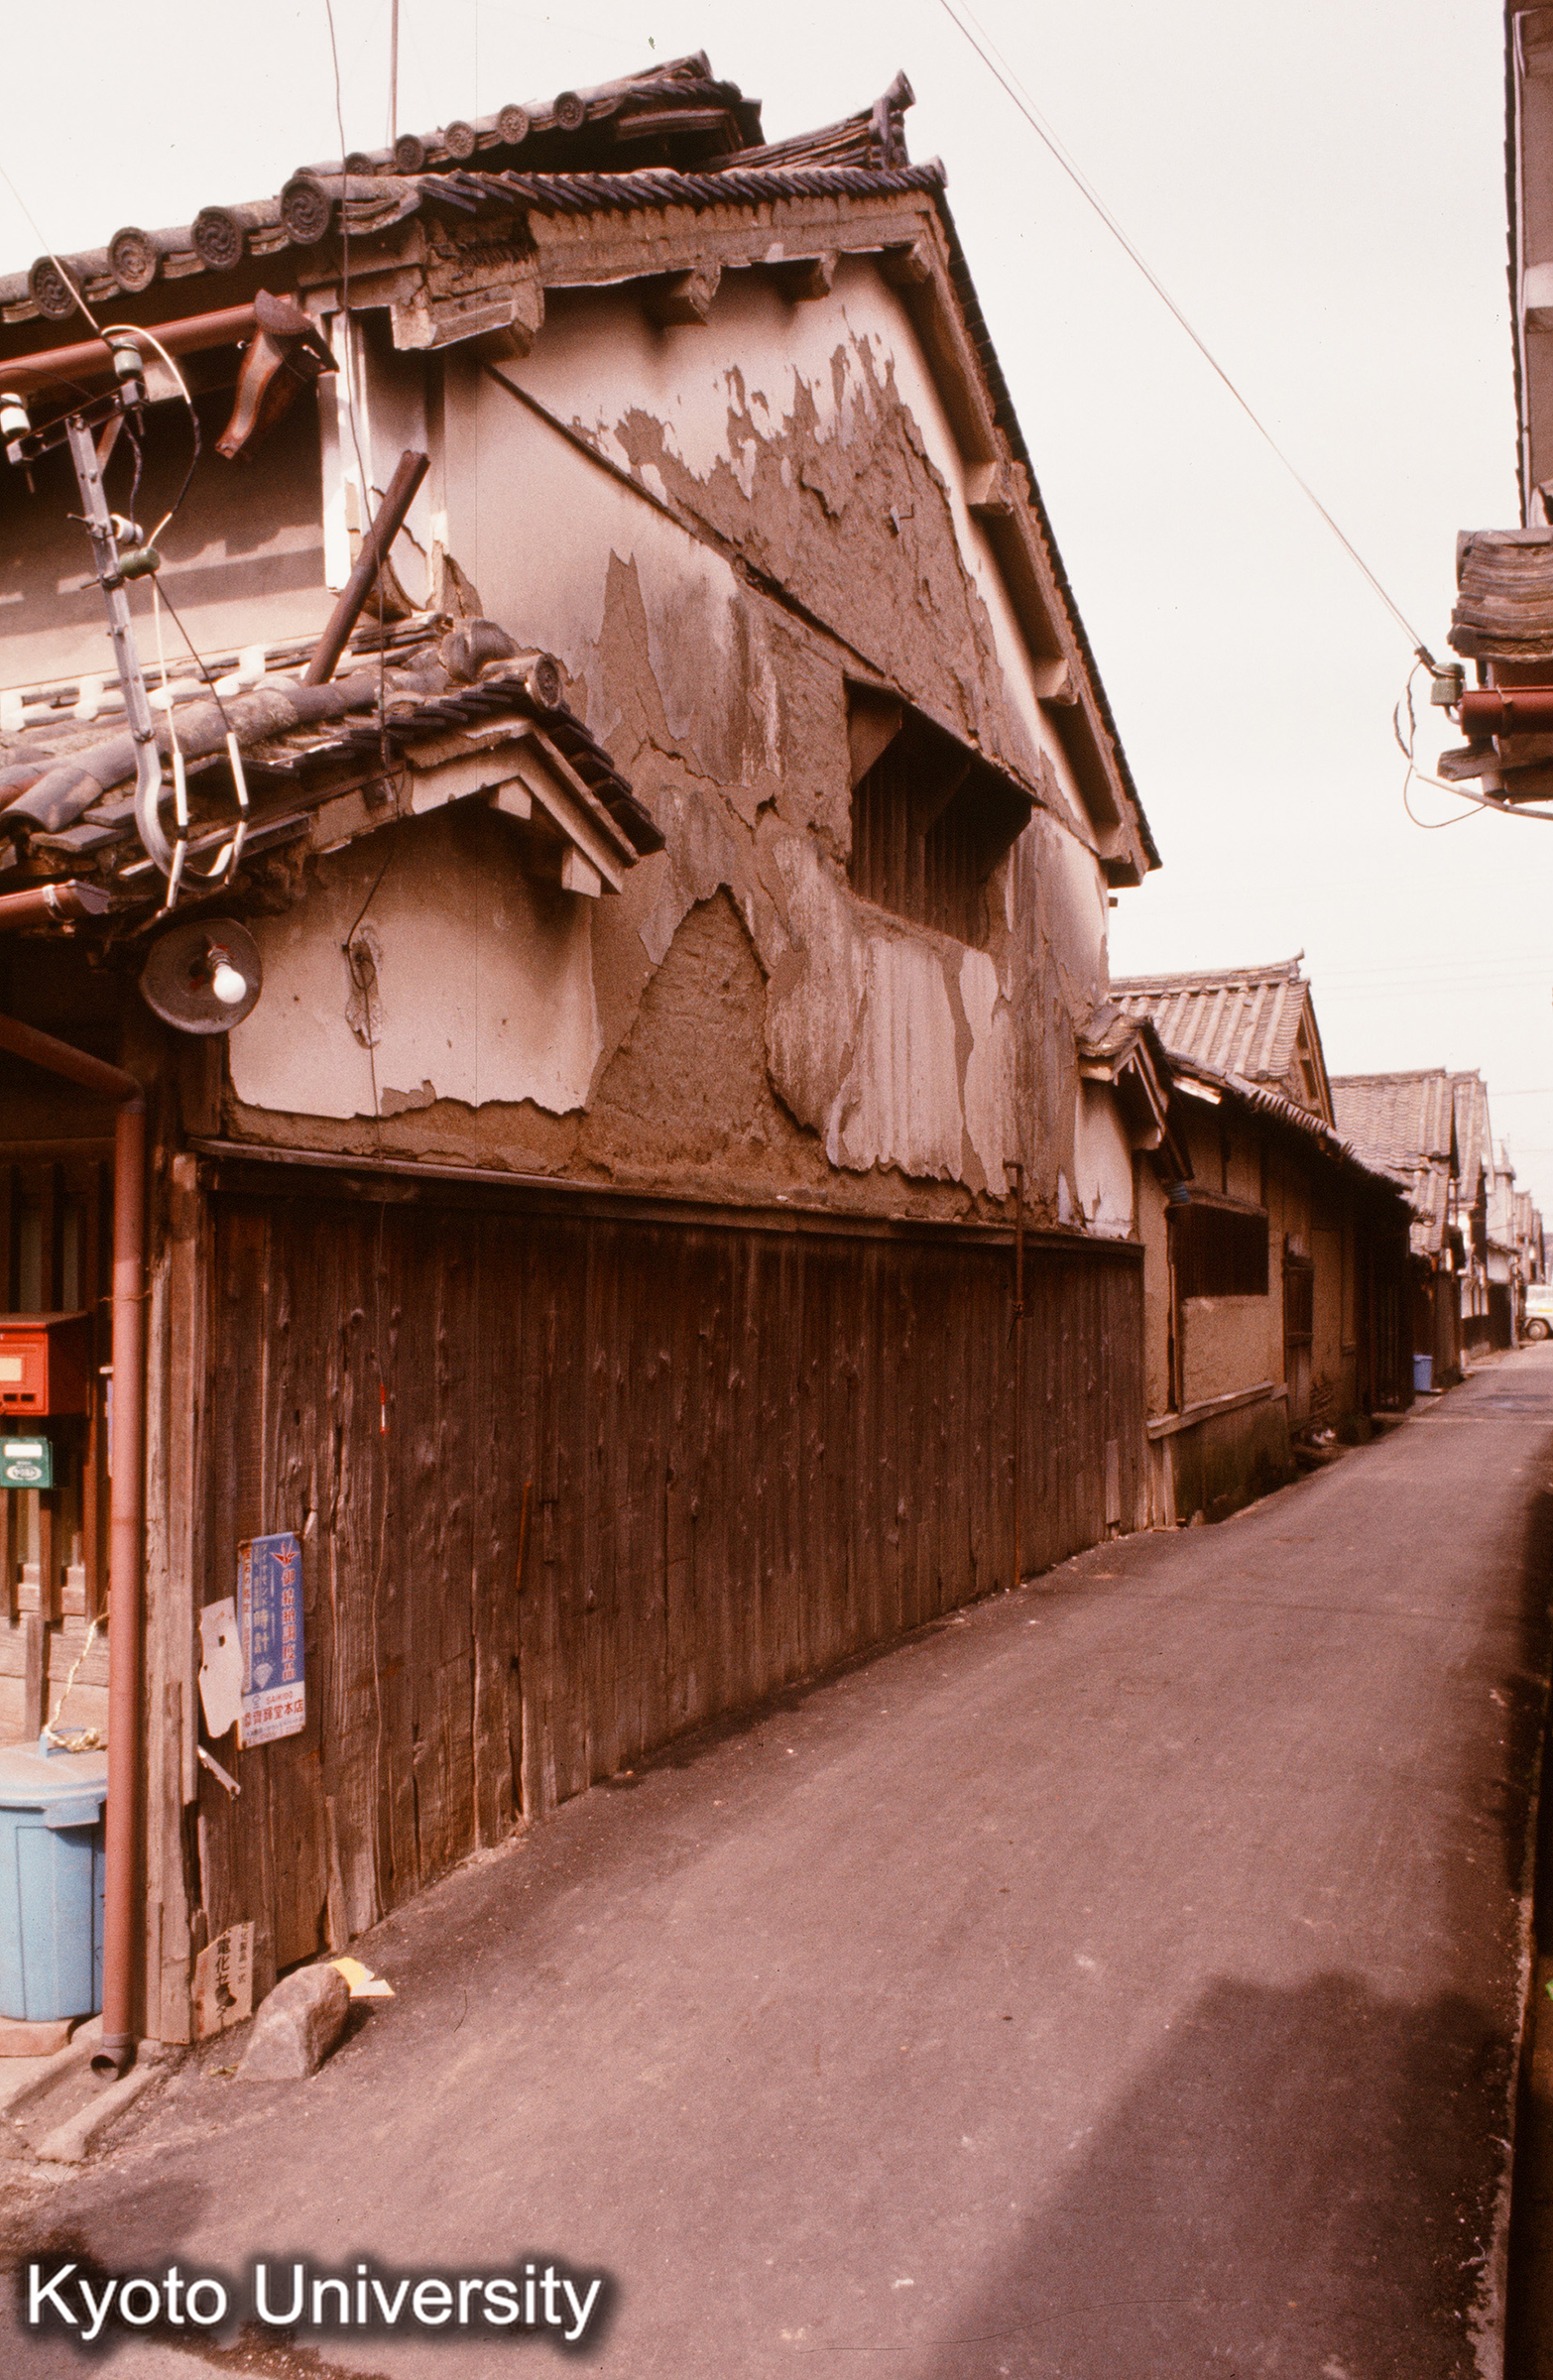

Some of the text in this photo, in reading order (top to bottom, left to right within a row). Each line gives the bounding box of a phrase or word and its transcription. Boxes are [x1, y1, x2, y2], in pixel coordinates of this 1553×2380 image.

[253, 1607, 270, 1654] 時計
[281, 1568, 297, 1682] 御結納調度品
